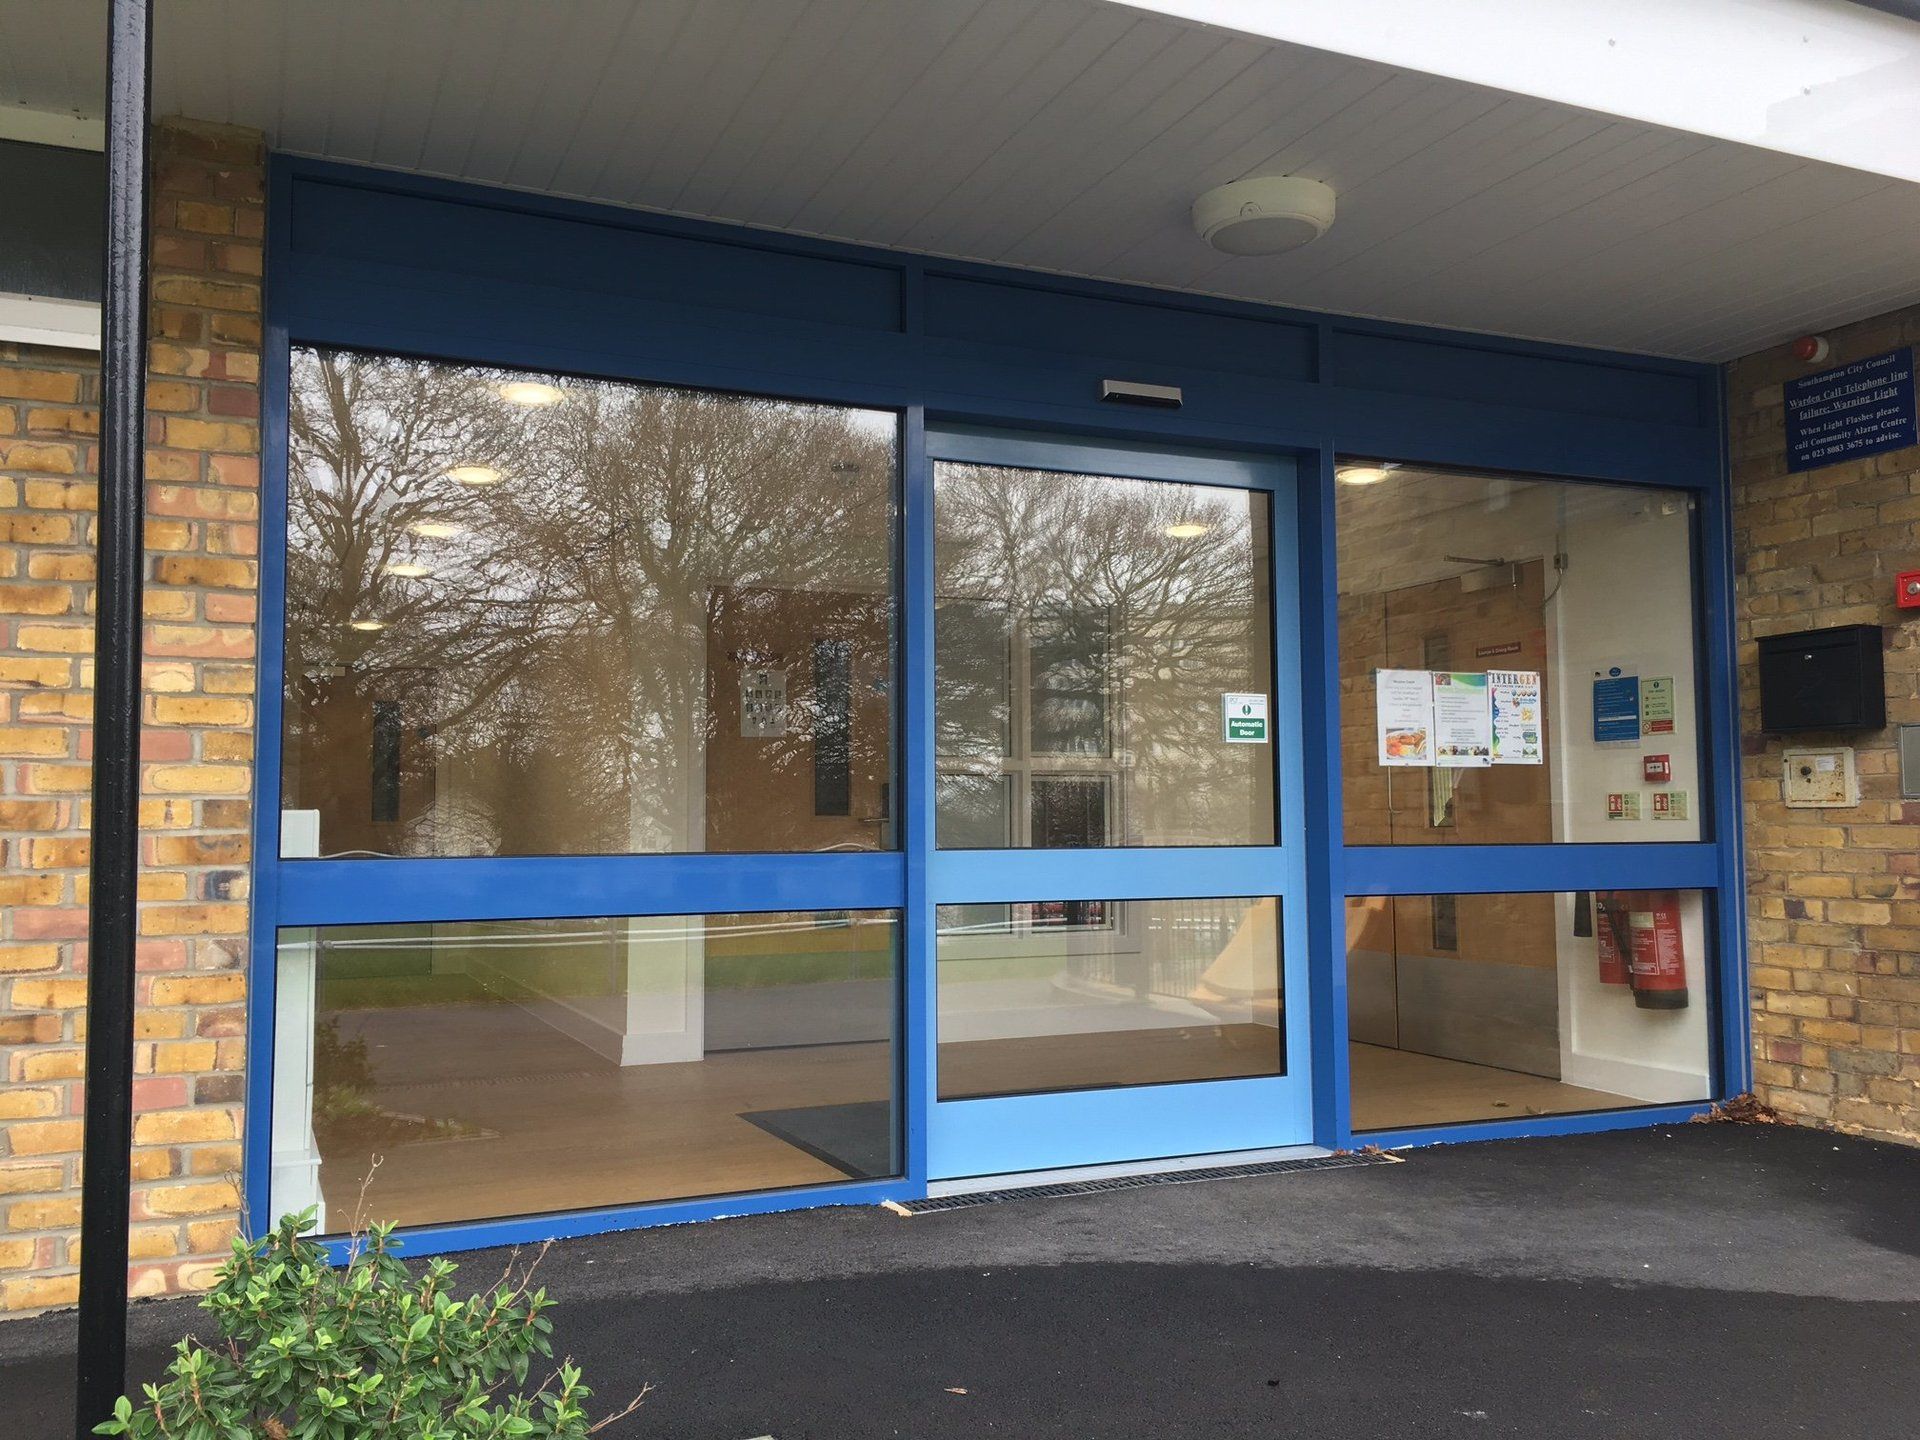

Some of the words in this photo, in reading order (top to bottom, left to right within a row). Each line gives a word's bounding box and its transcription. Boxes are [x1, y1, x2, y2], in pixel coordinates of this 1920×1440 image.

[1798, 370, 1845, 389] Southampton
[1847, 365, 1863, 375] City
[1866, 354, 1896, 370] Council
[1789, 394, 1821, 410] Warden
[1823, 386, 1842, 400] Call
[1845, 376, 1888, 395] Telephone
[1891, 369, 1909, 382] line
[1833, 395, 1872, 411] Warning
[1874, 386, 1898, 400] Light
[1794, 442, 1809, 451] call
[1810, 430, 1852, 447] Community
[1854, 424, 1878, 436] Alarm
[1881, 416, 1907, 429] Centre
[1800, 425, 1821, 436] When
[1823, 420, 1843, 431] Light
[1846, 413, 1874, 425] Flashes
[1876, 405, 1900, 419] please
[1801, 453, 1810, 461] on
[1811, 448, 1825, 458] 023
[1827, 445, 1844, 455] 8083
[1846, 439, 1864, 450] 3675
[1865, 437, 1874, 446] to
[1876, 431, 1902, 444] advise.
[1491, 672, 1537, 685] INTERGEN
